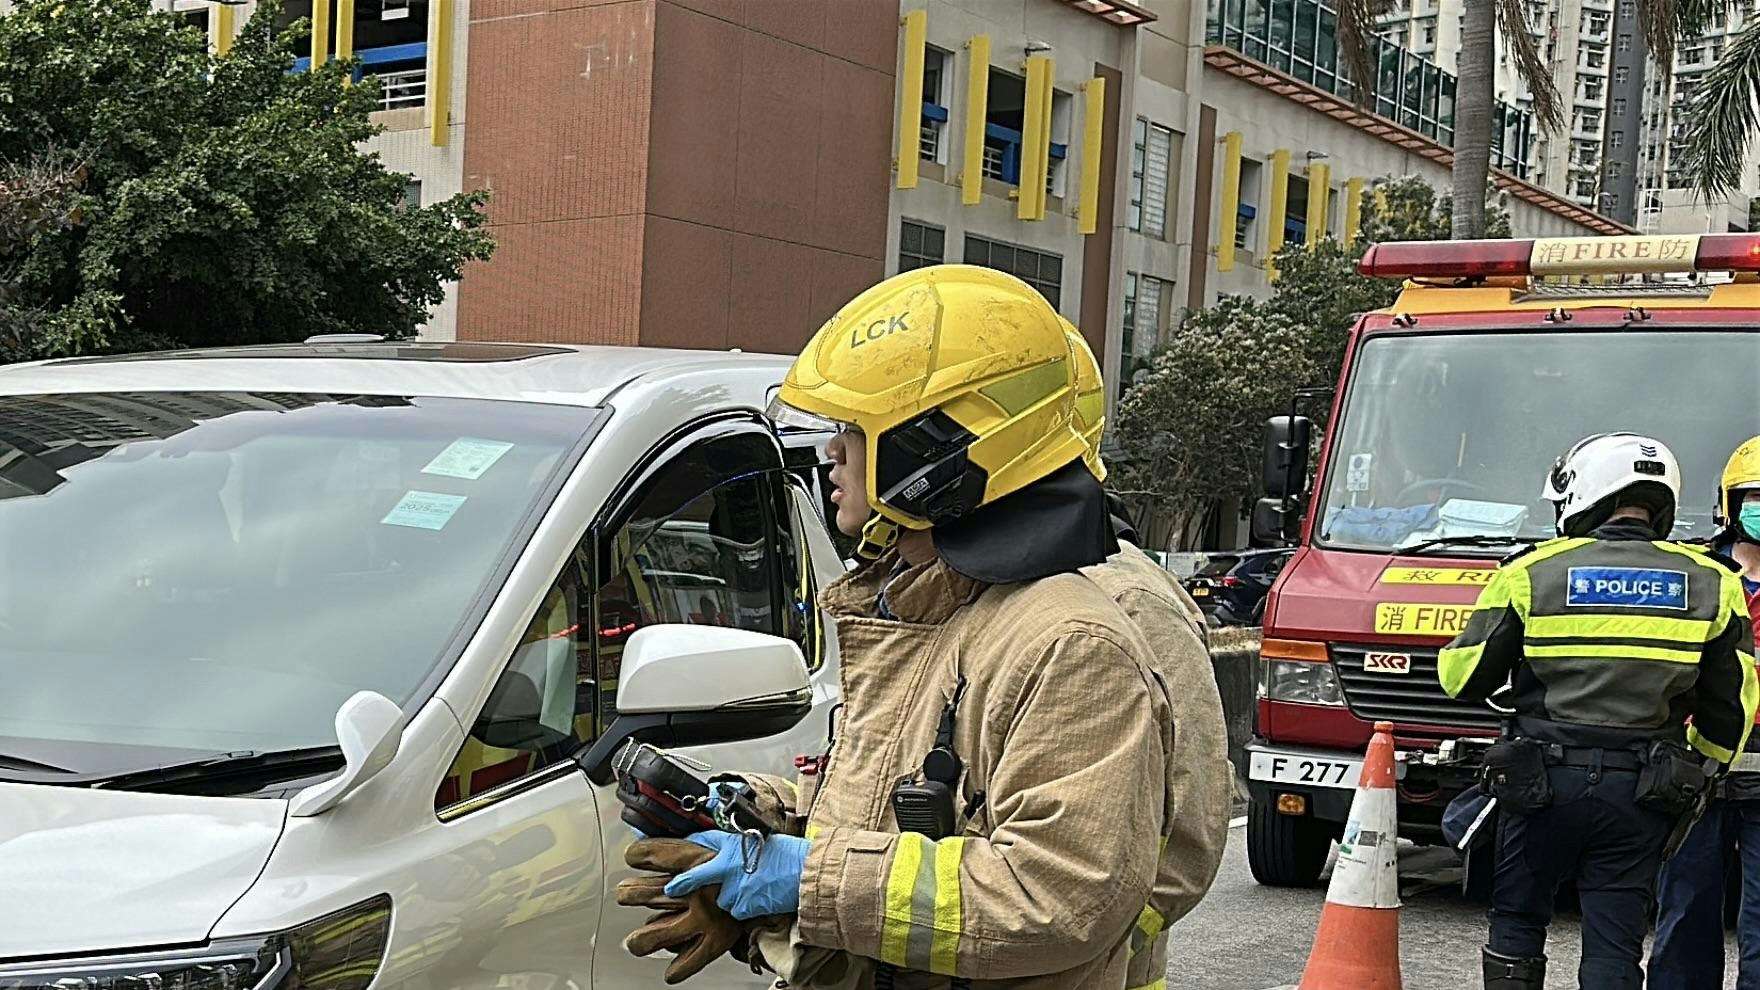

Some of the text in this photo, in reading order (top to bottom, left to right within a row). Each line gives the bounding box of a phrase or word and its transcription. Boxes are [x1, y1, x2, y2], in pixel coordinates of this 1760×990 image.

[1540, 239, 1689, 263] 消 FIRE 防
[851, 311, 910, 349] LCK
[1595, 580, 1662, 596] POLICE
[1381, 606, 1473, 631] 消 FIRE
[1272, 758, 1350, 784] F 277
